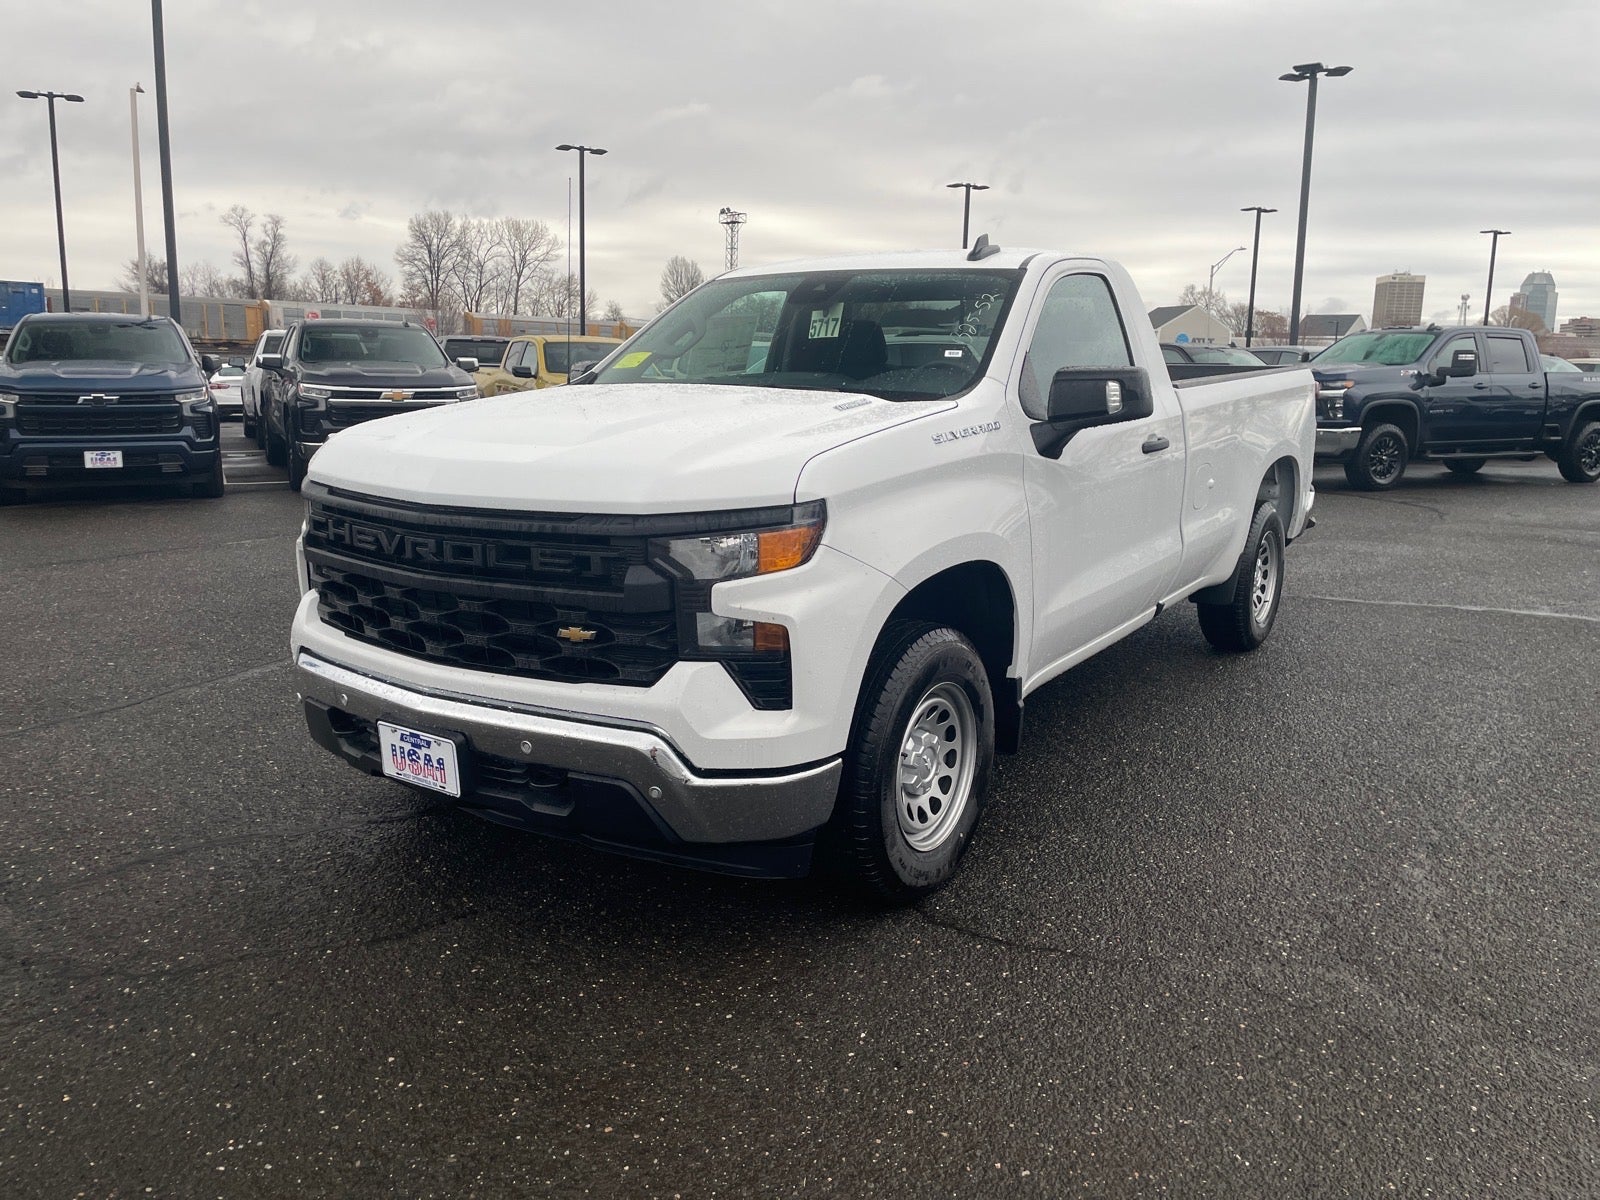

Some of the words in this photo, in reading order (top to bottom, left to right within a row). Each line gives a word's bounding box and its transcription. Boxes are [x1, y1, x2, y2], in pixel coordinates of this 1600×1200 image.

[809, 317, 840, 338] 5717
[931, 421, 1001, 444] SILVERADO
[309, 514, 622, 576] CHEVROLET
[402, 735, 429, 748] CENTRAL
